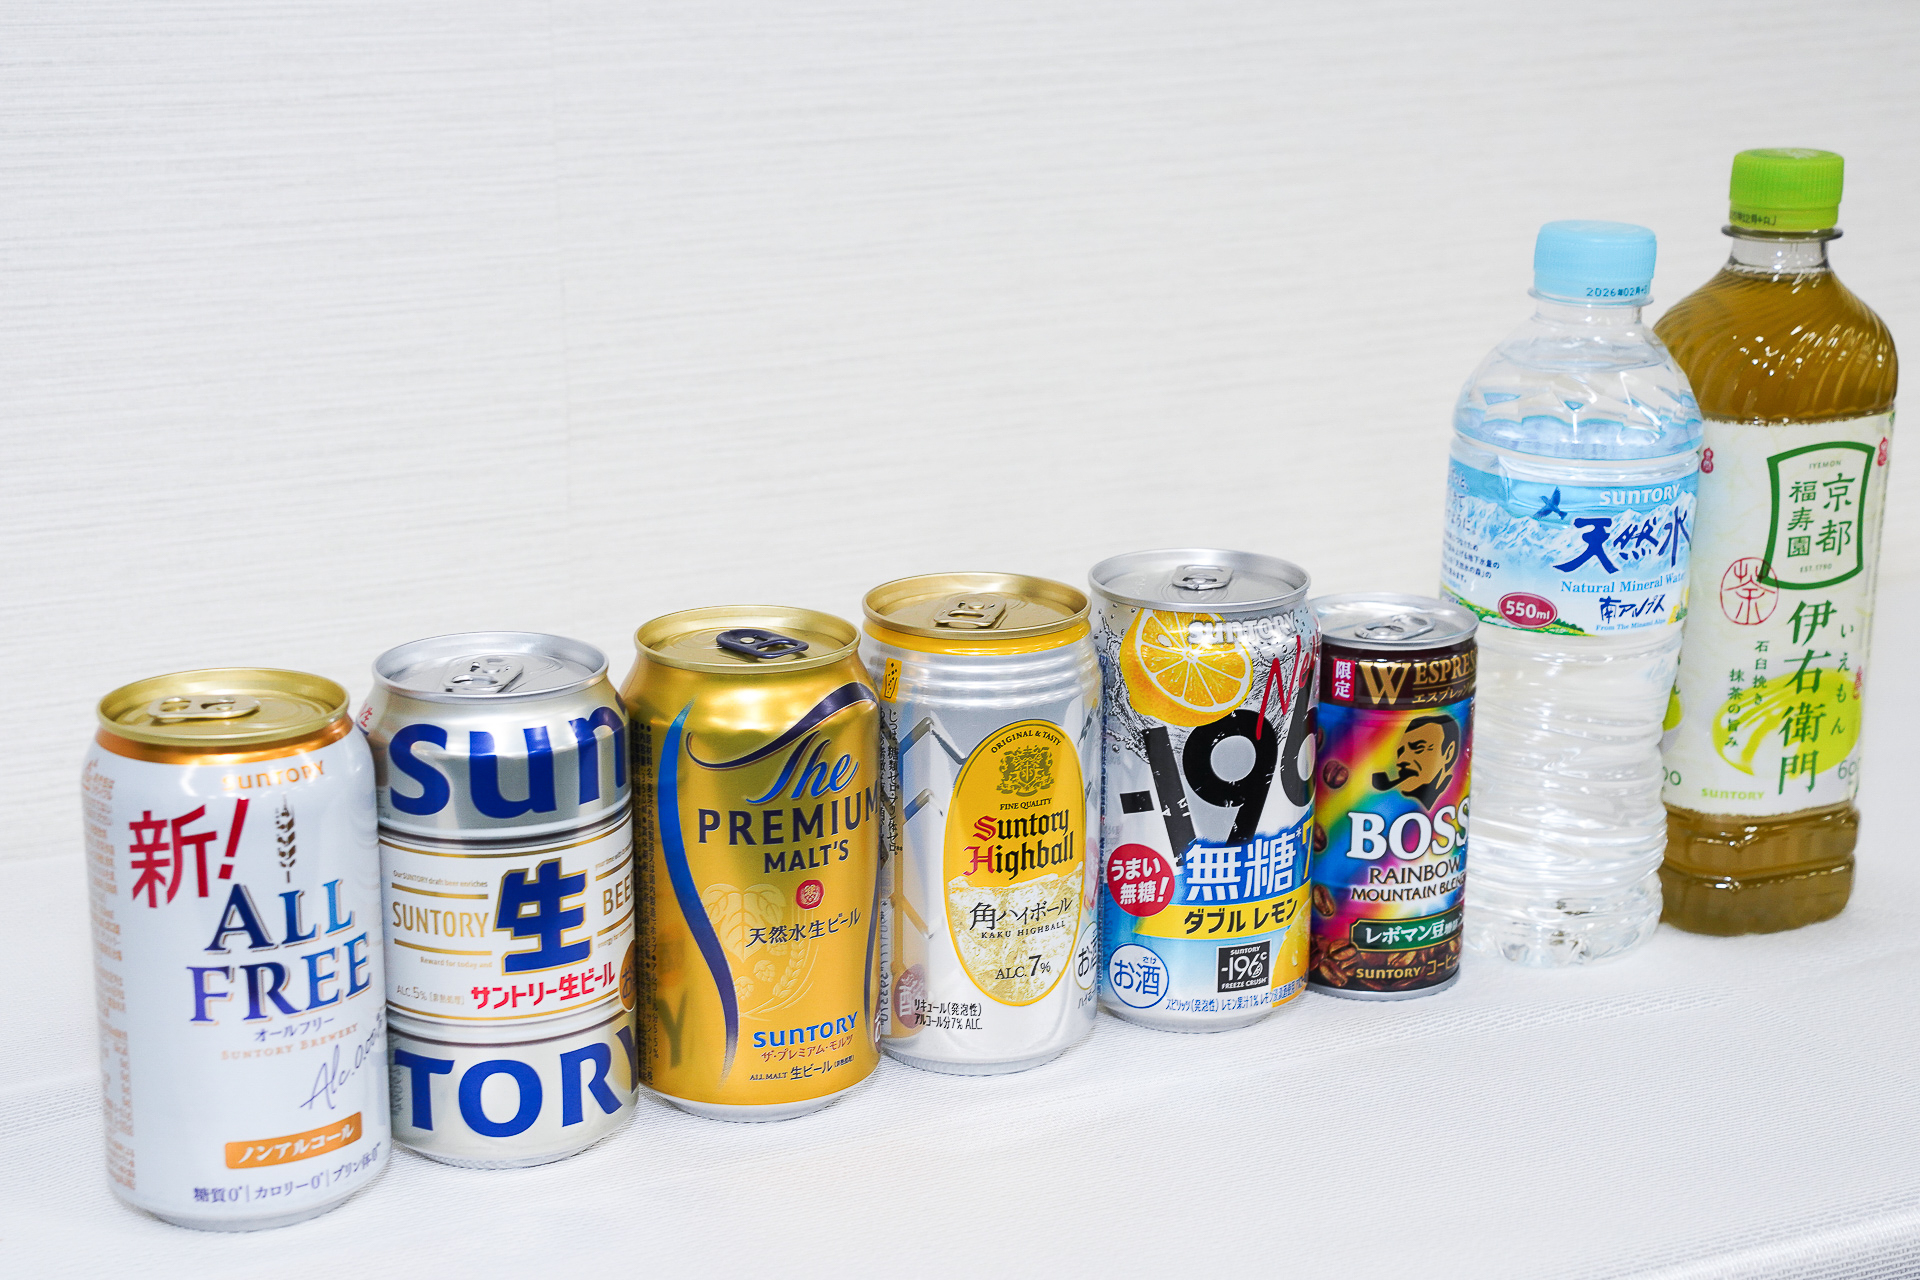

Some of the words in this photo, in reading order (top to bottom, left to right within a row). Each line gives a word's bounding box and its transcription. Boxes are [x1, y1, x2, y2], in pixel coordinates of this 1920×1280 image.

[1809, 460, 1841, 469] IYEMON
[1600, 483, 1681, 506] SUNTORY
[1787, 480, 1818, 558] 福寿園
[1815, 473, 1856, 556] 京都
[1552, 505, 1691, 574] 天然水
[1561, 580, 1615, 593] Natural
[1620, 578, 1664, 593] Mineral
[1506, 599, 1550, 620] 550ml
[1599, 594, 1666, 624] 南アルプス
[1334, 660, 1351, 698] 限定
[1359, 661, 1412, 705] W
[1752, 640, 1770, 707] 石臼挽き
[1830, 623, 1854, 736] いえもん
[1724, 668, 1745, 748] 抹茶の旨み
[1778, 599, 1838, 796] 伊右衛門
[991, 730, 1034, 754] ORIGINAL
[1042, 731, 1062, 746] TASTY
[222, 759, 326, 791] SUNTORY
[745, 730, 859, 805] The
[698, 780, 879, 846] PREMIUM
[1000, 801, 1020, 810] FINE
[1020, 798, 1053, 810] QUALITY
[1701, 788, 1765, 801] SUNTORY
[973, 808, 1070, 842] Suntory
[1346, 797, 1469, 861] BOSS
[129, 797, 251, 909] 新!
[764, 839, 850, 874] MALT'S
[962, 831, 1074, 880] Highball
[1111, 856, 1161, 880] うまい
[1369, 854, 1461, 885] RAINBOW
[1351, 884, 1437, 901] MOUNTAIN
[204, 879, 356, 953] ALL
[393, 901, 489, 938] SUNTORY
[493, 857, 593, 976] 生
[746, 908, 862, 948] 天然水生ビール
[969, 897, 1073, 931] 角ハイボール
[981, 930, 1012, 939] KAKU
[1017, 920, 1066, 937] HIGHBALL
[1184, 908, 1247, 935] ダブル
[1253, 898, 1298, 930] レモン
[420, 956, 445, 967] Reward
[445, 959, 456, 968] for
[457, 961, 477, 970] today
[1230, 945, 1261, 956] SUNTORY
[186, 932, 372, 1025] FREE
[470, 961, 616, 1010] サントリー生ビール
[1113, 960, 1161, 996] お酒
[1221, 981, 1245, 989] FREEZE
[1356, 966, 1421, 979] SUNTORY
[221, 1044, 293, 1061] SUNTORY
[300, 1022, 360, 1050] BREWERY
[254, 1016, 335, 1043] オールフリー
[753, 1011, 858, 1048] SUNTORY
[790, 1060, 834, 1081] 生ビール
[237, 1124, 356, 1164] ノンアルコール
